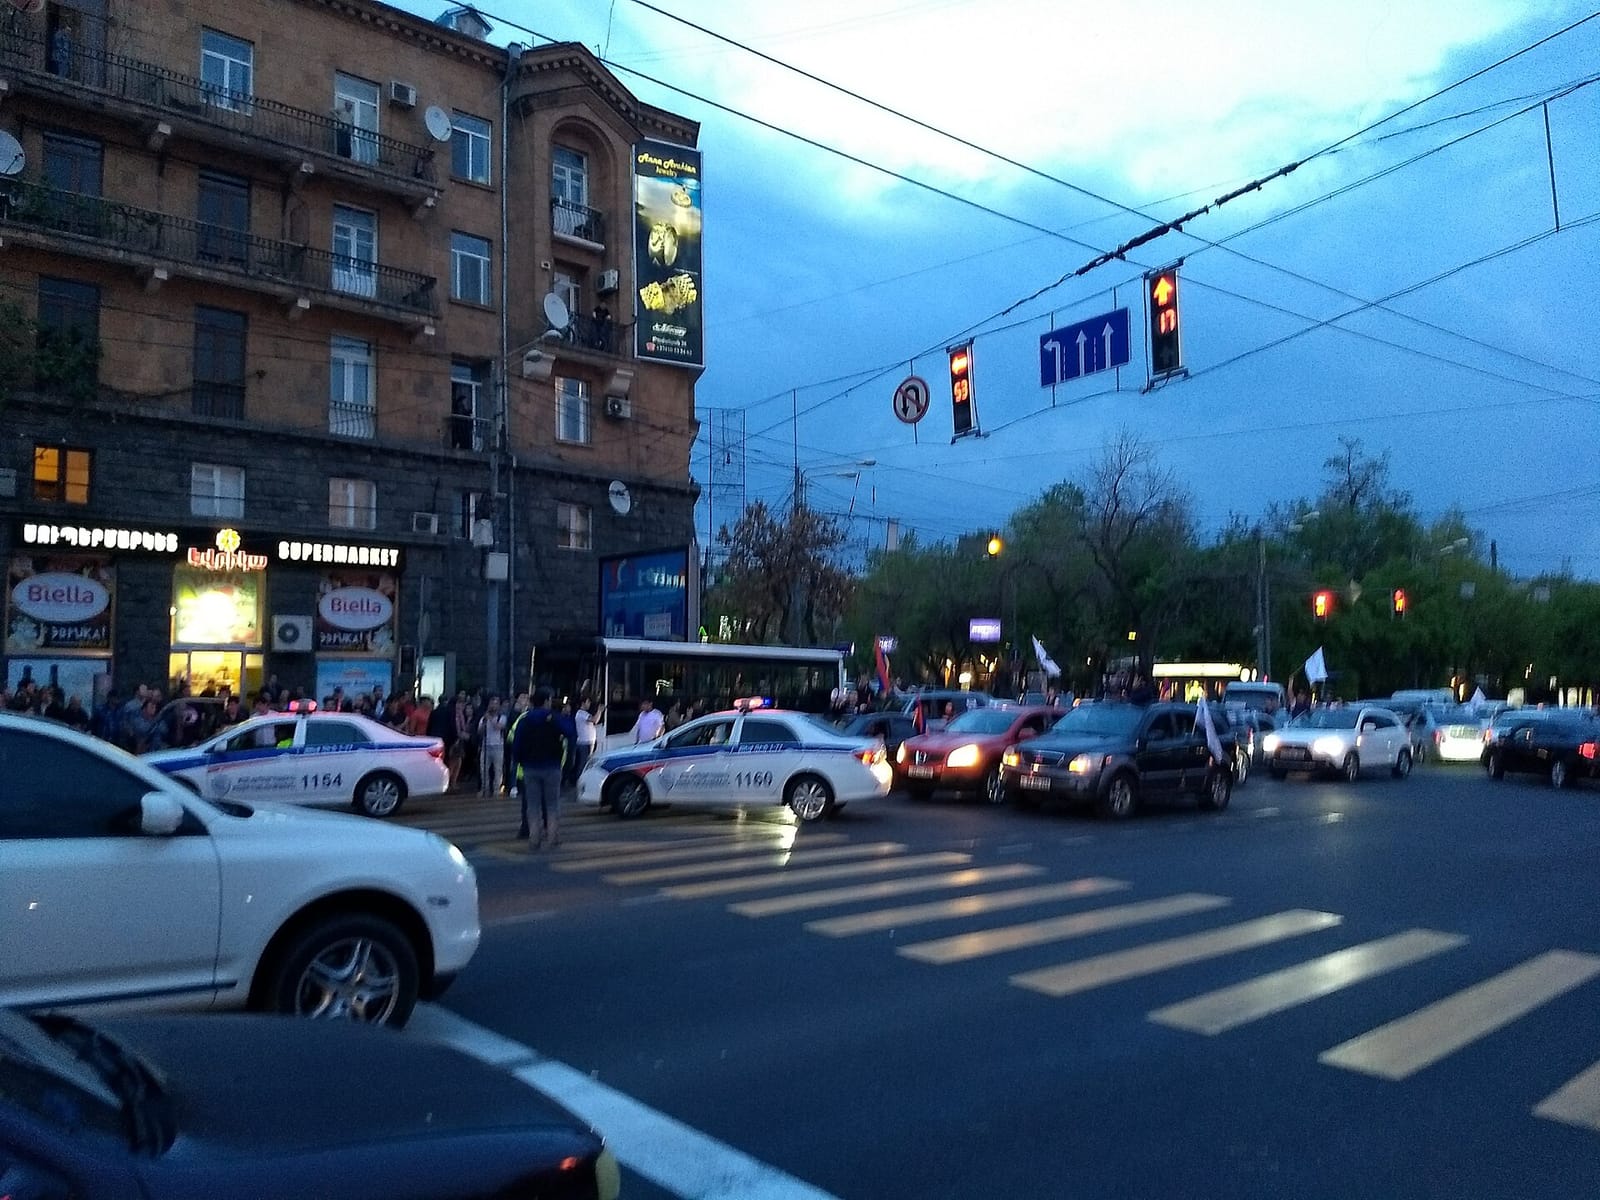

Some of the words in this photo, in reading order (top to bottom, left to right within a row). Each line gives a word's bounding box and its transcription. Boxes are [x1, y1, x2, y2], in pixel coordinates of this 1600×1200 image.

[638, 153, 662, 166] Anna
[1160, 309, 1175, 334] 17
[278, 540, 399, 567] SUPERMARKET
[28, 584, 95, 604] Biella
[330, 597, 383, 615] Biella
[735, 770, 774, 790] 1160
